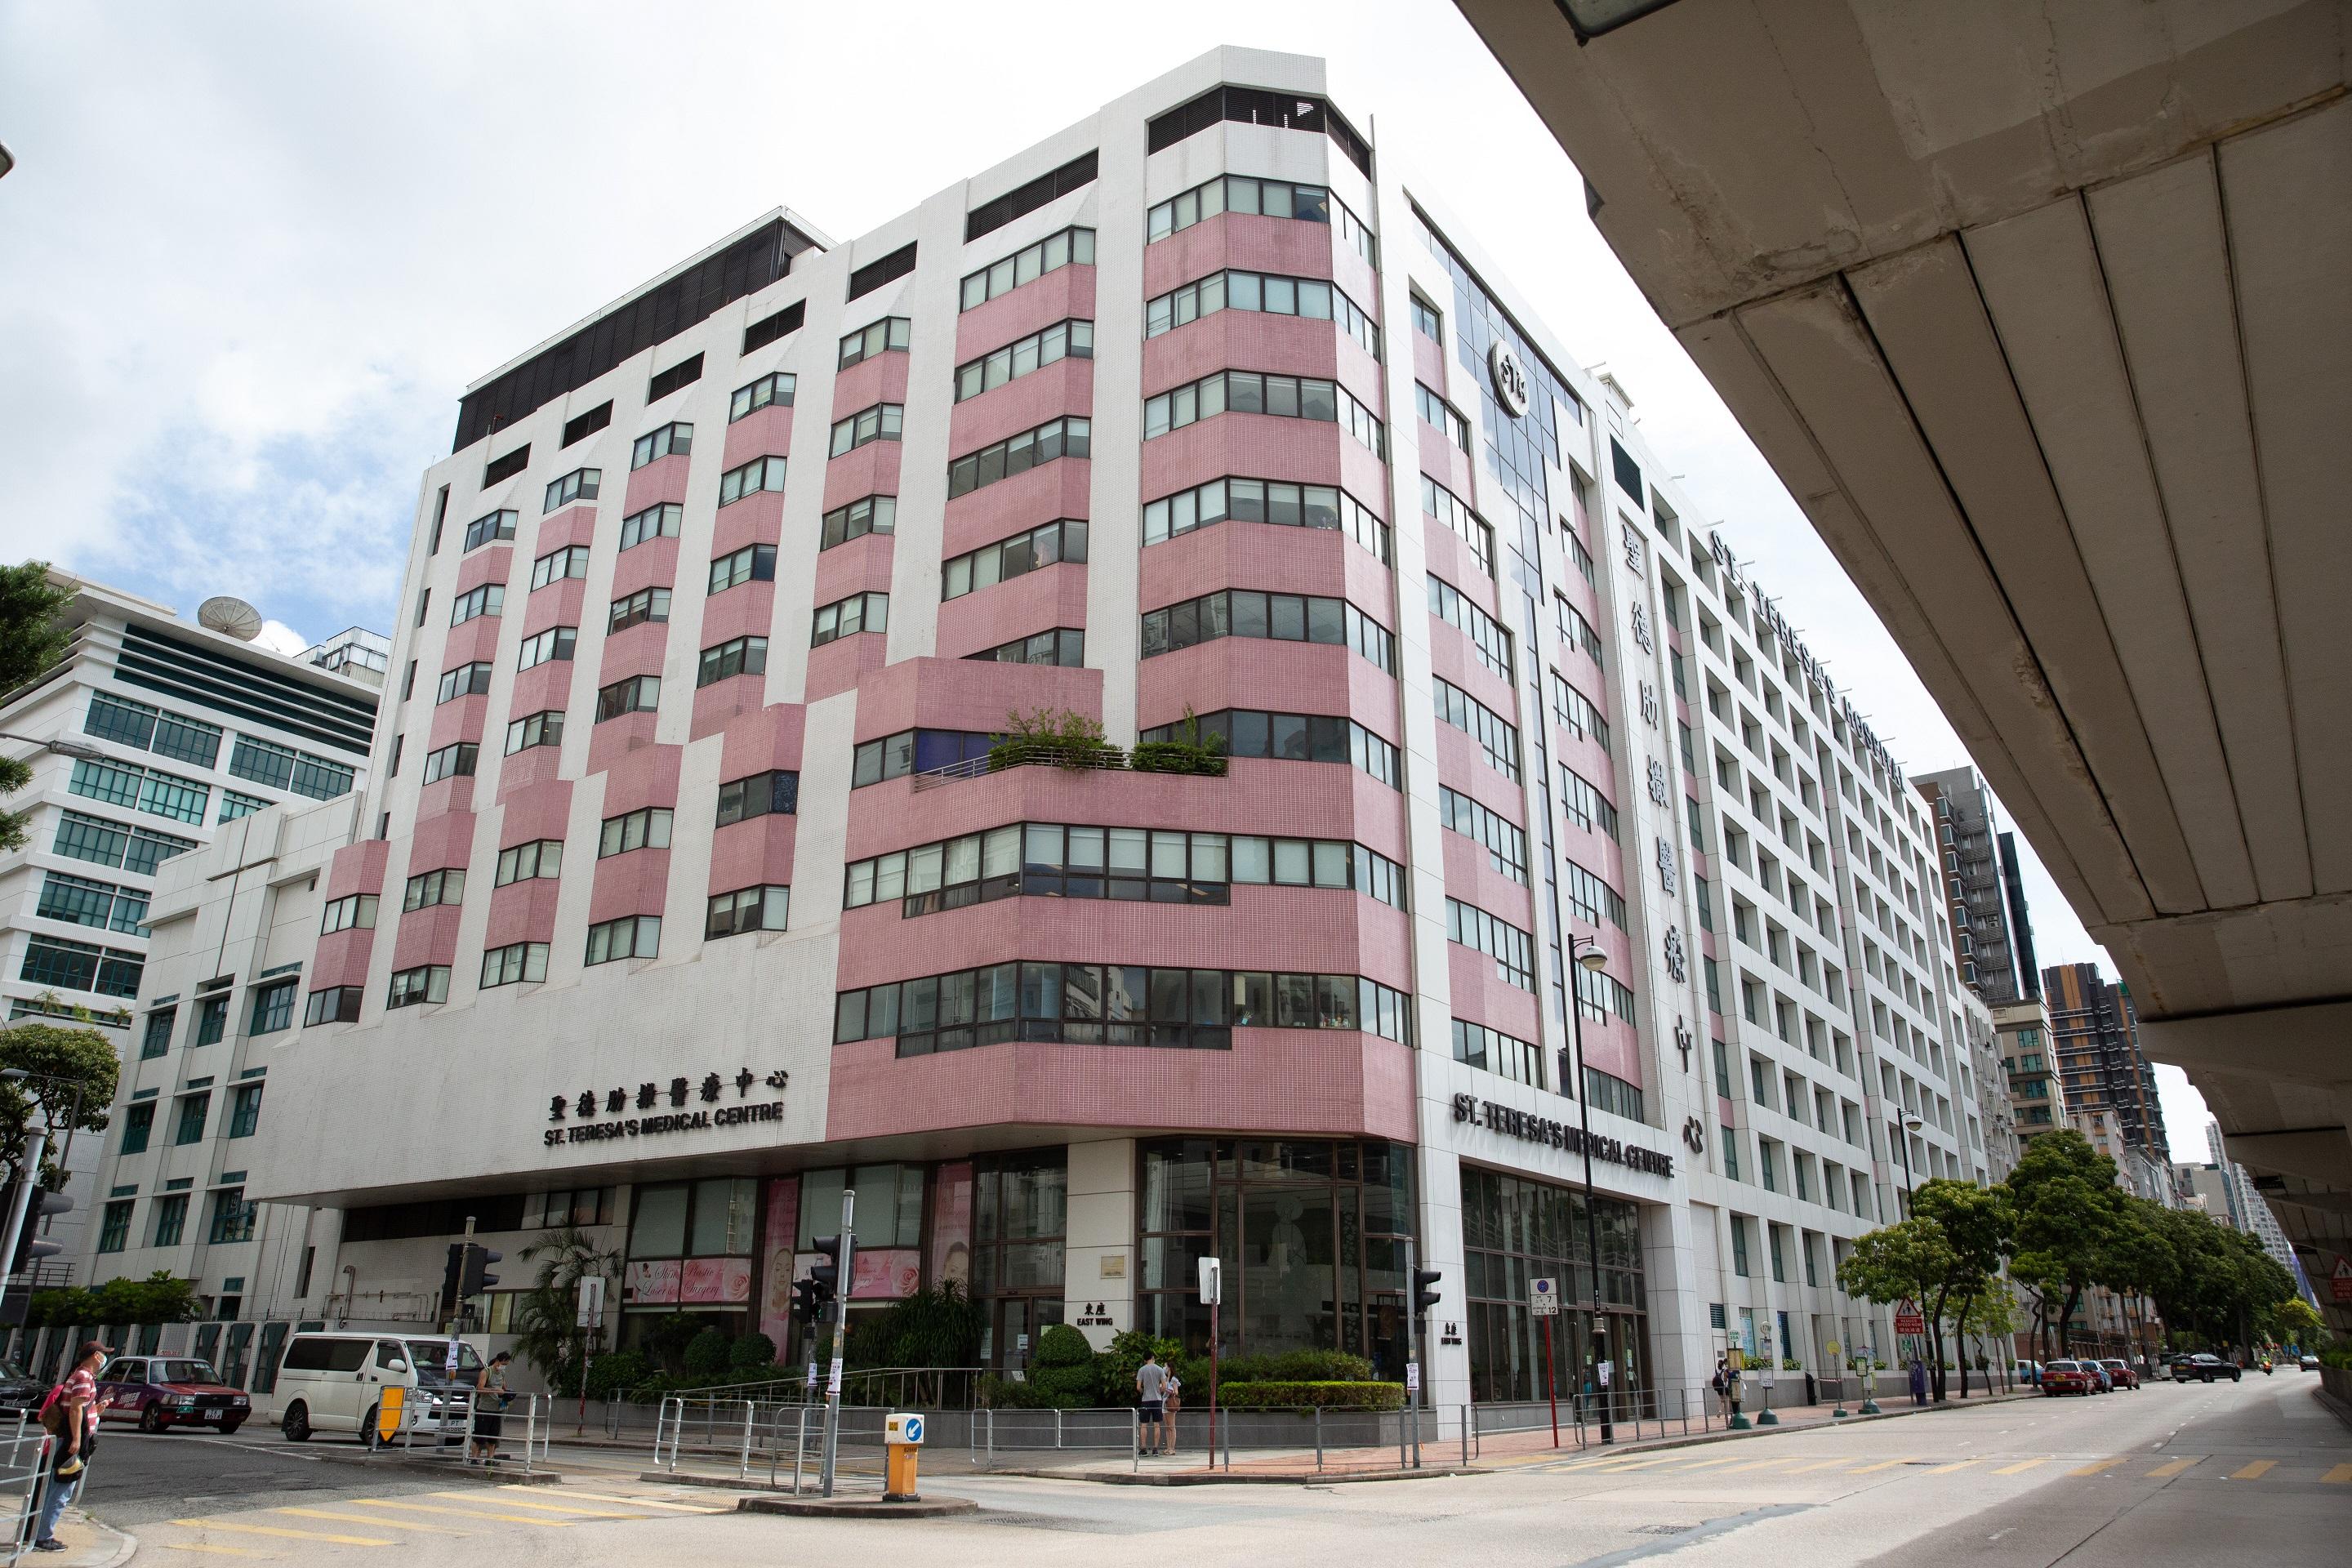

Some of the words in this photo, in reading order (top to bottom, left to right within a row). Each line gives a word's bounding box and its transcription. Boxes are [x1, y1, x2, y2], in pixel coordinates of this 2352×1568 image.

[1711, 529, 1744, 592] ST.
[1753, 581, 1836, 704] TERESA'S
[1842, 695, 1907, 794] HOSPITAL
[1622, 523, 1704, 1154] 聖德肋撒醫療中心
[548, 1067, 789, 1121] 聖德肋撒醫療中心
[543, 1129, 566, 1146] ST.
[568, 1119, 639, 1143] TERESA'S
[640, 1110, 712, 1135] MEDICAL
[714, 1102, 784, 1126] CENTRE
[1454, 1091, 1483, 1127] ST.
[1483, 1100, 1563, 1149] TERESA'S
[1625, 1143, 1675, 1178] CENTRE
[642, 1280, 665, 1296] Laser
[654, 1265, 675, 1280] Skin
[684, 1281, 720, 1299] Surgery
[1076, 1317, 1094, 1326] EAST
[1095, 1317, 1113, 1326] WING
[1084, 1302, 1107, 1316] 東座
